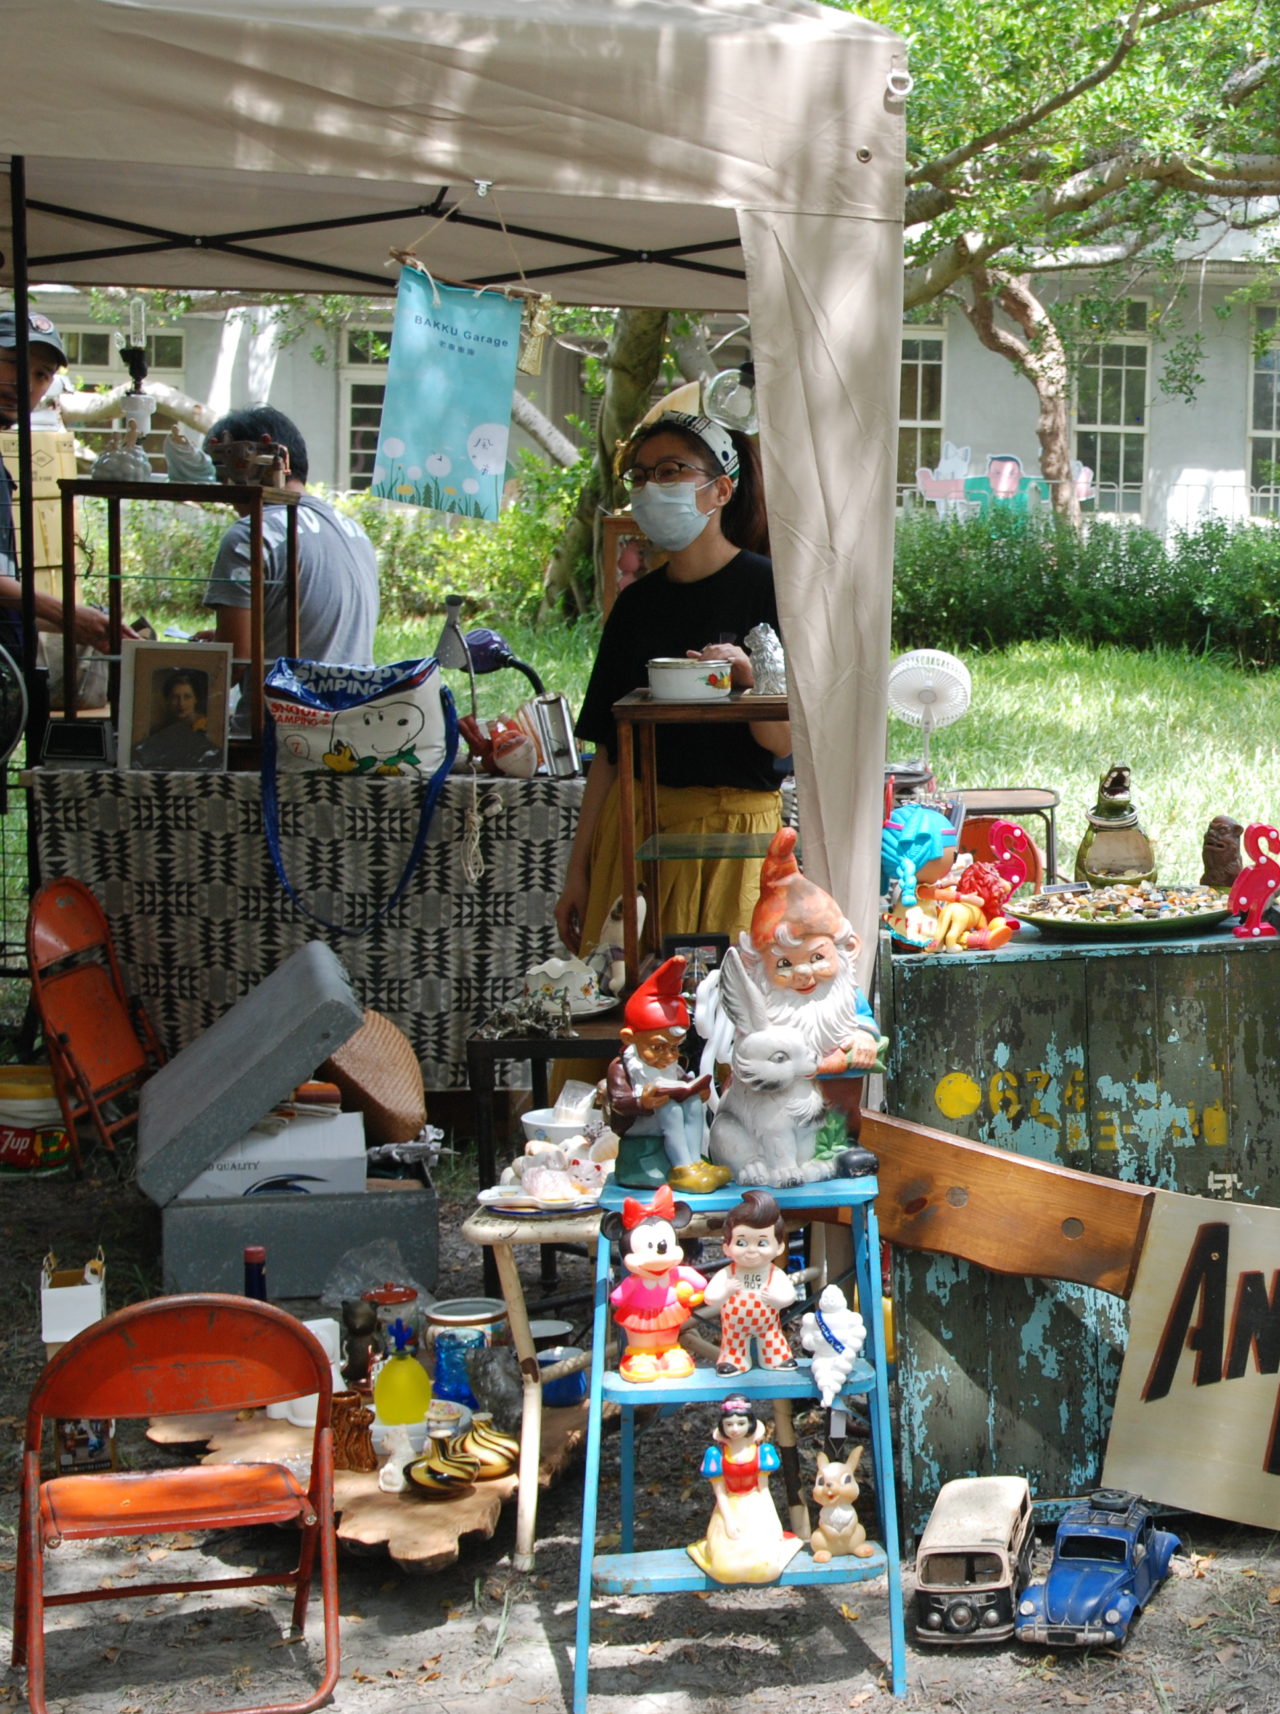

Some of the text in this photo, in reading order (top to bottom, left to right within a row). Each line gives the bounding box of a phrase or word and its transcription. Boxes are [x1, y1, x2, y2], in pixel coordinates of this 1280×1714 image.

[414, 315, 509, 347] BAKKU Garage
[303, 678, 384, 696] AMPING
[0, 1130, 31, 1156] 7up
[216, 1161, 260, 1171] QUALITY
